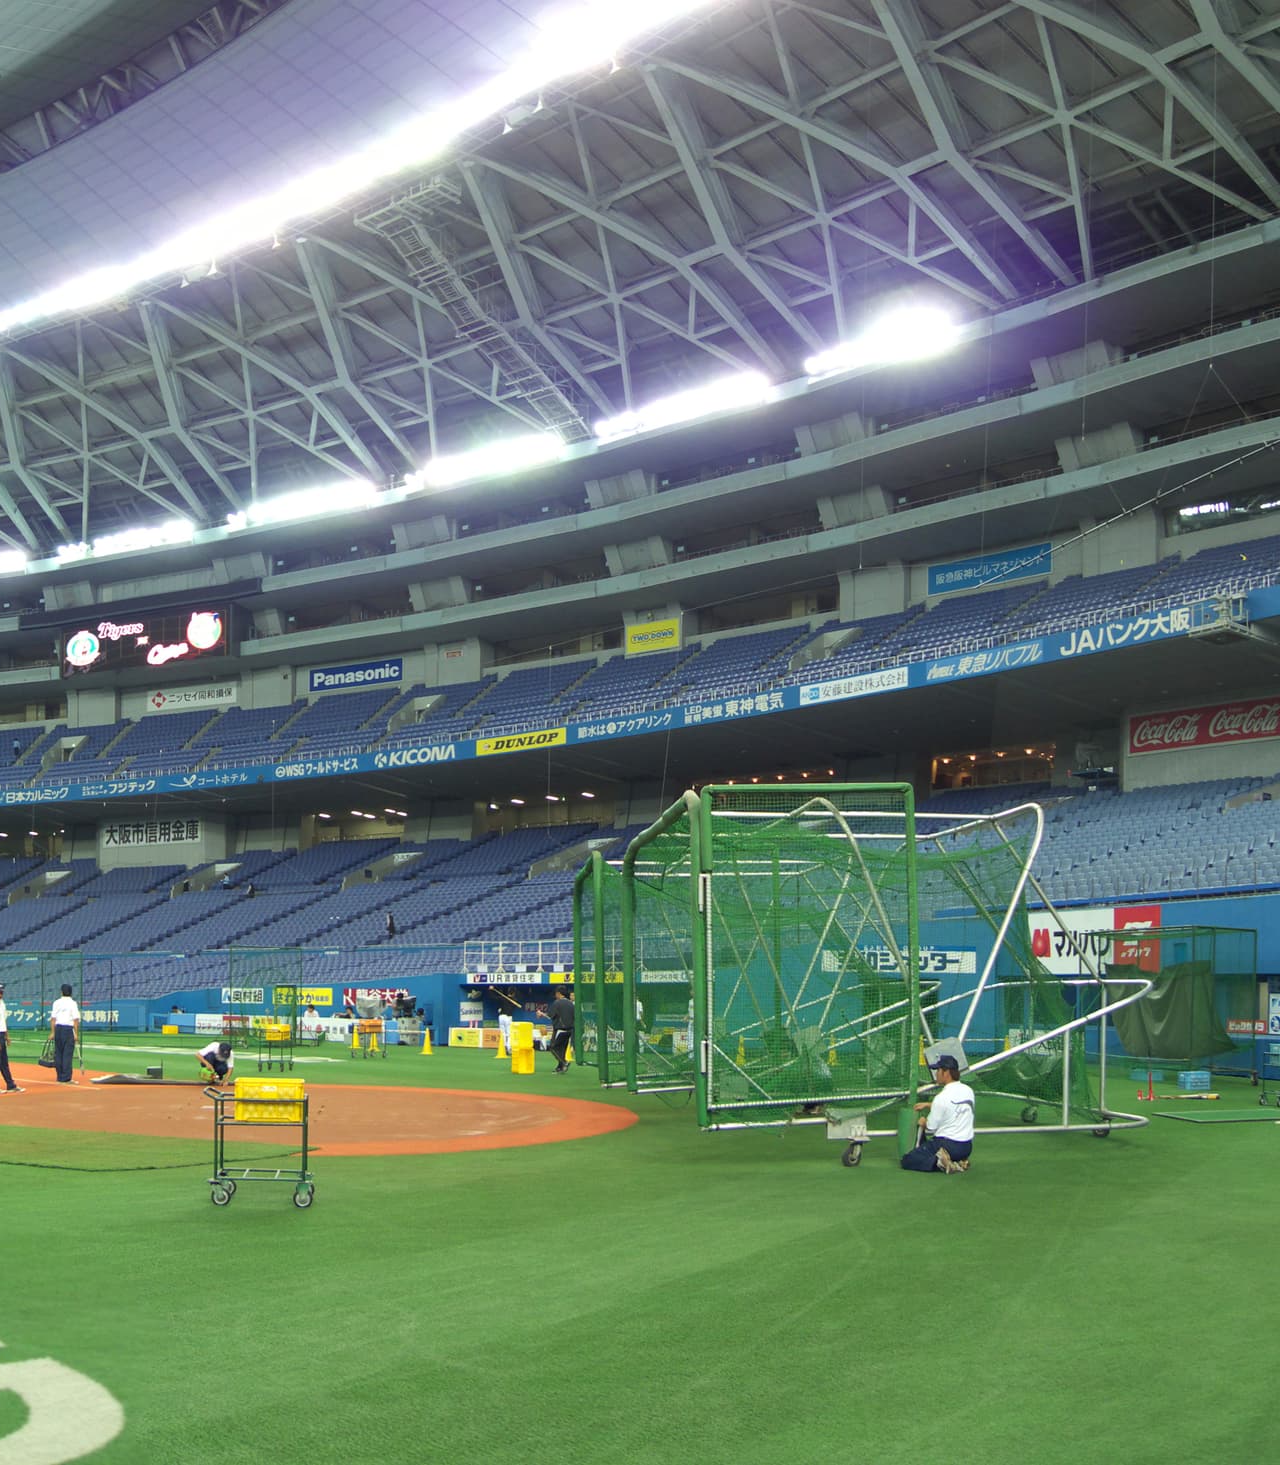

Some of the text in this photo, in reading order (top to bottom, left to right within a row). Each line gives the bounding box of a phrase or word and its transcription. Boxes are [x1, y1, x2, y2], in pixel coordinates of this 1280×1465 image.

[936, 549, 1044, 585] 阪急阪神ビルマネジメント
[98, 622, 143, 639] Tigers
[632, 630, 673, 642] TWO DOWN
[1059, 607, 1190, 656] JAバンク大阪
[313, 663, 400, 688] Panasonic
[822, 671, 906, 698] 安藤建設株式会社
[168, 687, 232, 703] ニッセイ同和損保
[725, 692, 784, 716] 東神電気
[684, 705, 702, 715] LED
[493, 732, 559, 752] DUNLOP
[388, 744, 456, 767] KICONA
[285, 756, 358, 778] WSG ワールドサービス
[108, 780, 156, 794] フジテック
[198, 773, 248, 785] コートホテル
[5, 788, 69, 803] 日本カルミック
[105, 820, 200, 845] 大阪市信用金庫
